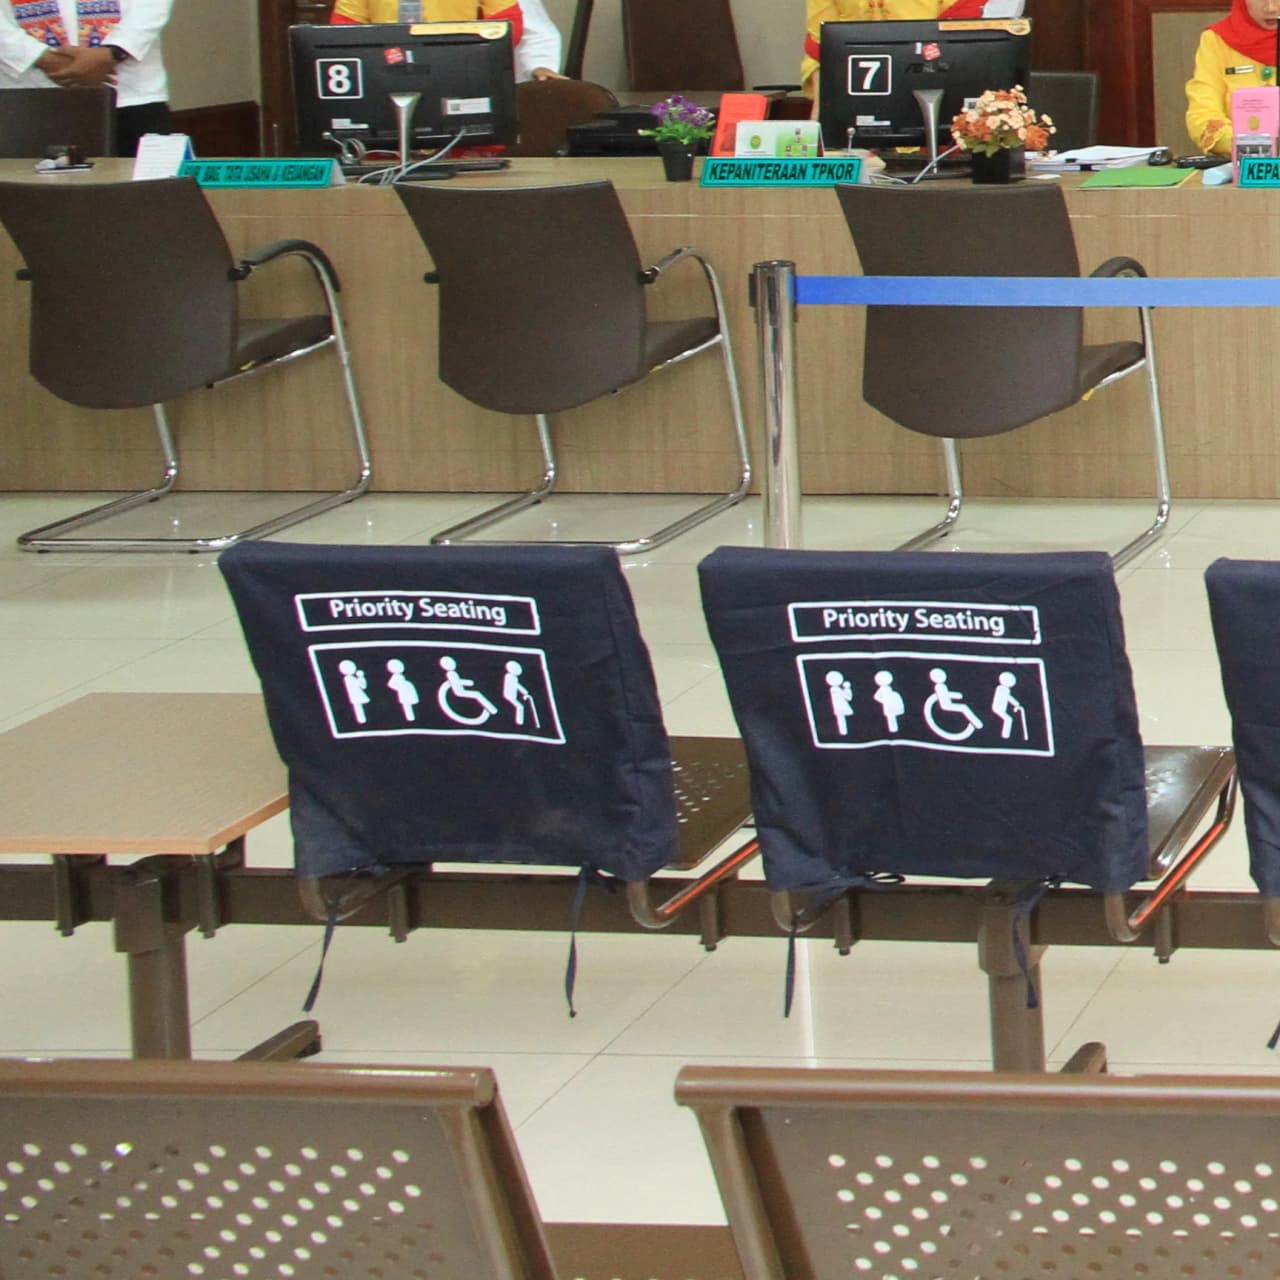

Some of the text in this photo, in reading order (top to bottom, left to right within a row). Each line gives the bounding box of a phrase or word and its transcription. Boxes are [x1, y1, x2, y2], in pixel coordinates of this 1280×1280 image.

[328, 64, 352, 94] 8
[858, 61, 881, 90] 7
[709, 163, 854, 180] KEPANITERAAN TPKOR
[329, 597, 507, 626] Priority Seating
[823, 608, 1005, 637] Priority Seating
